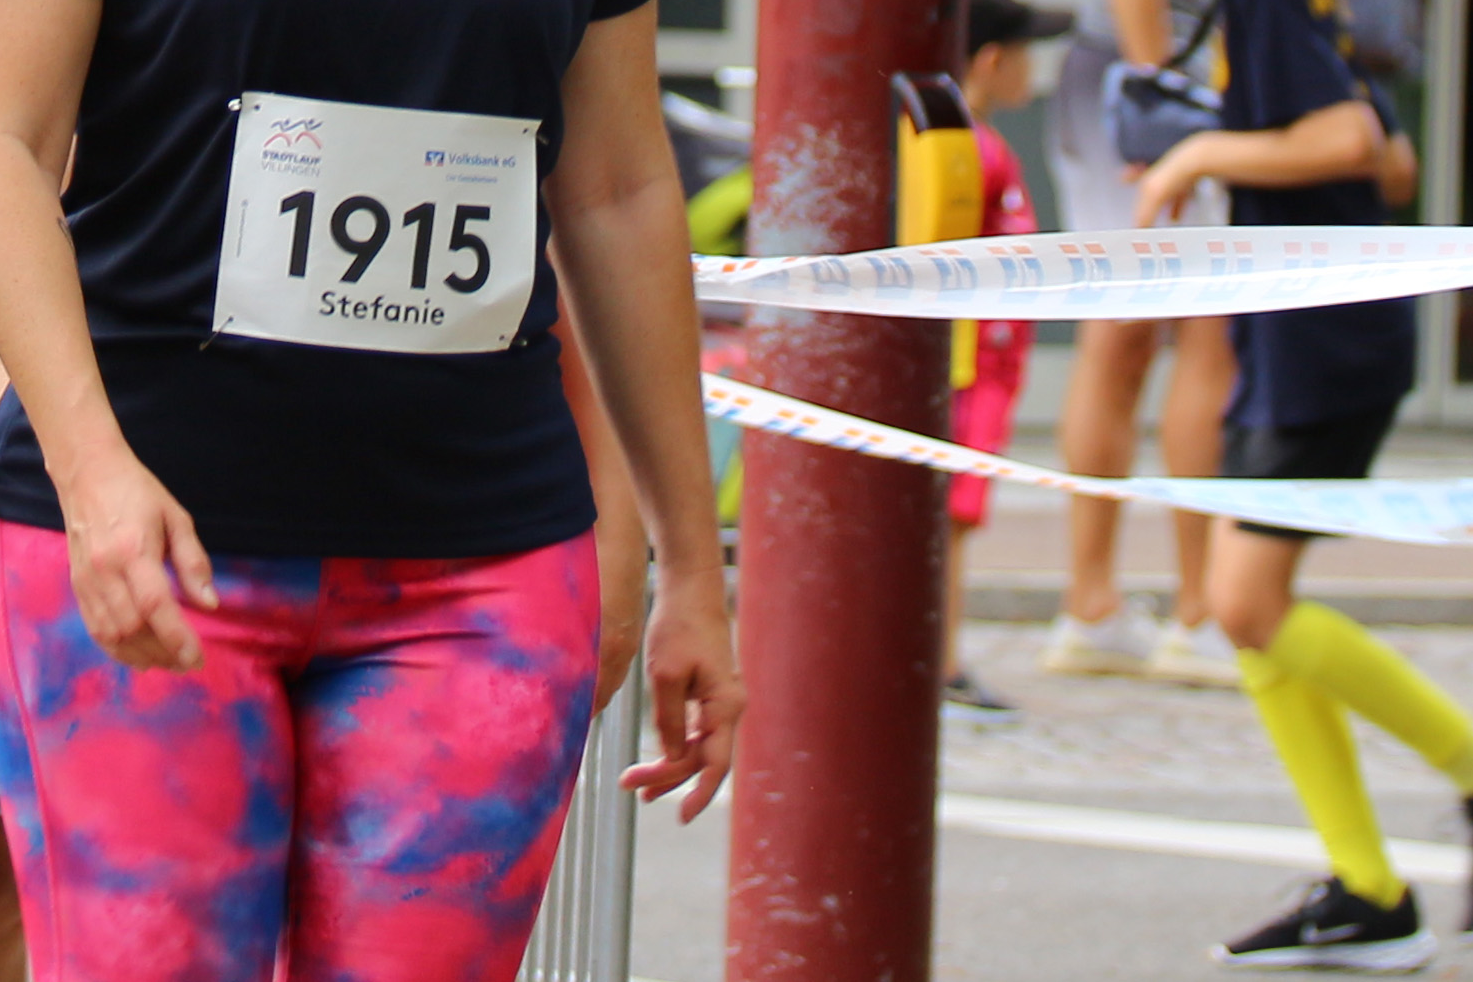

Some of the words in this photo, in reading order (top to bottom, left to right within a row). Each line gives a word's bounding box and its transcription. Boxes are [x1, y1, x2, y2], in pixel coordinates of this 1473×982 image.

[449, 152, 500, 167] Volksbank
[279, 190, 491, 295] 1915
[318, 290, 445, 326] Stefanie
